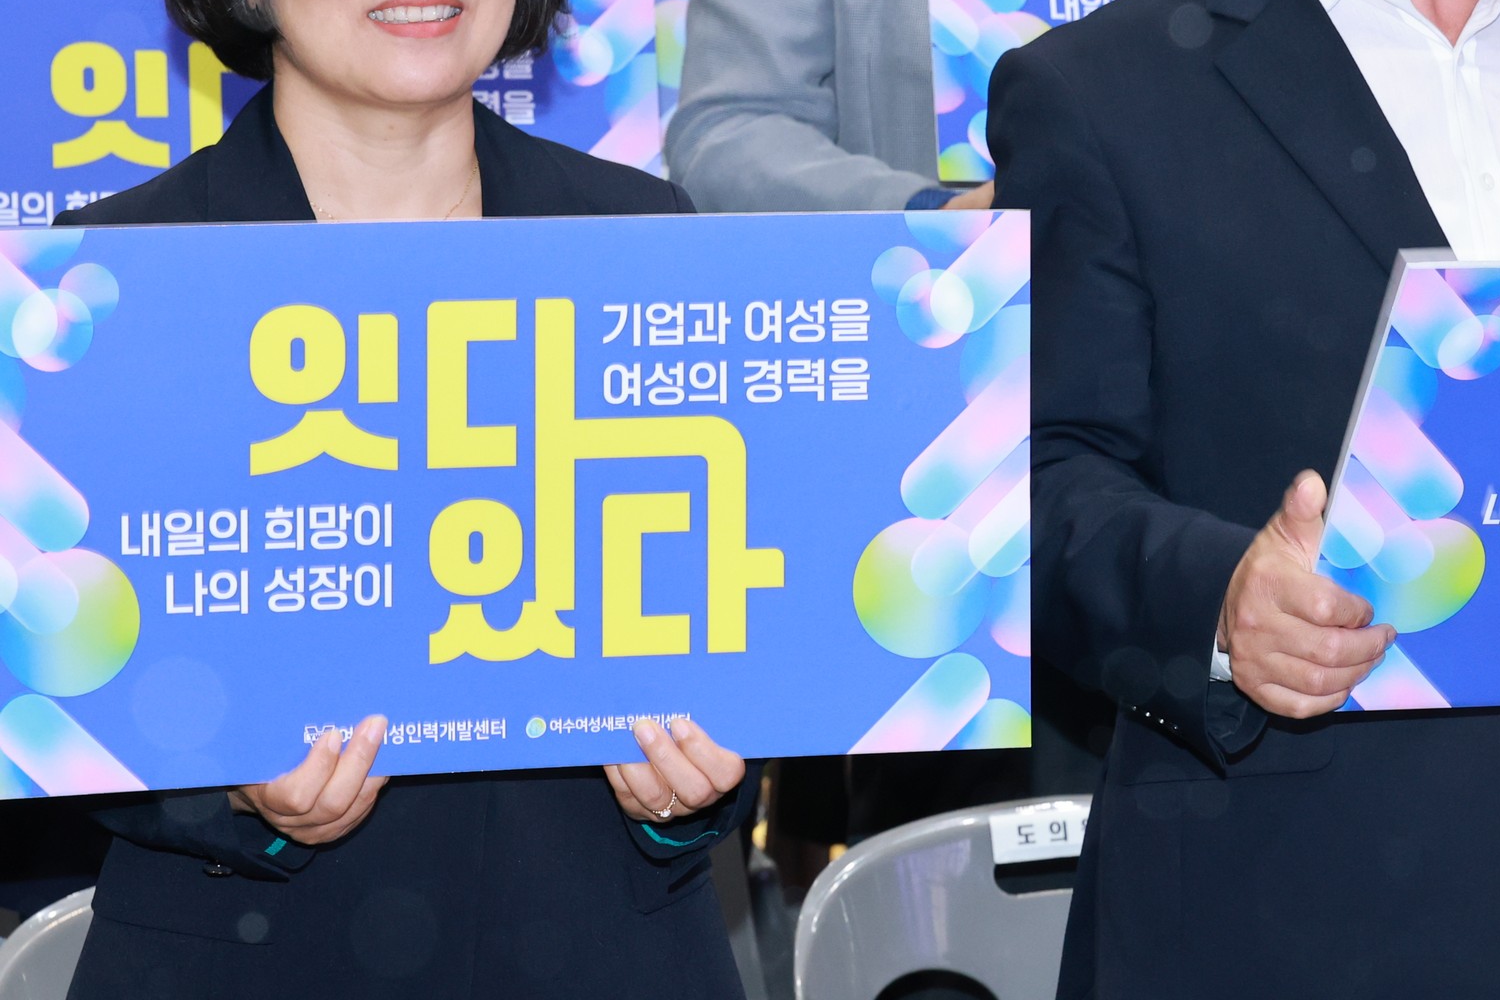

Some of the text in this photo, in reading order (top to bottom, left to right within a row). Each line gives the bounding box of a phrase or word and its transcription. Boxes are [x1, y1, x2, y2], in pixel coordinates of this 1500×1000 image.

[0, 191, 55, 227] 일의
[601, 296, 872, 348] 기업과 여성을
[249, 297, 576, 476] 잇다
[601, 355, 872, 406] 여성의 경력을
[119, 501, 395, 559] 내일의 희망이
[428, 440, 786, 666] 있다
[163, 560, 395, 618] 나의 성장이
